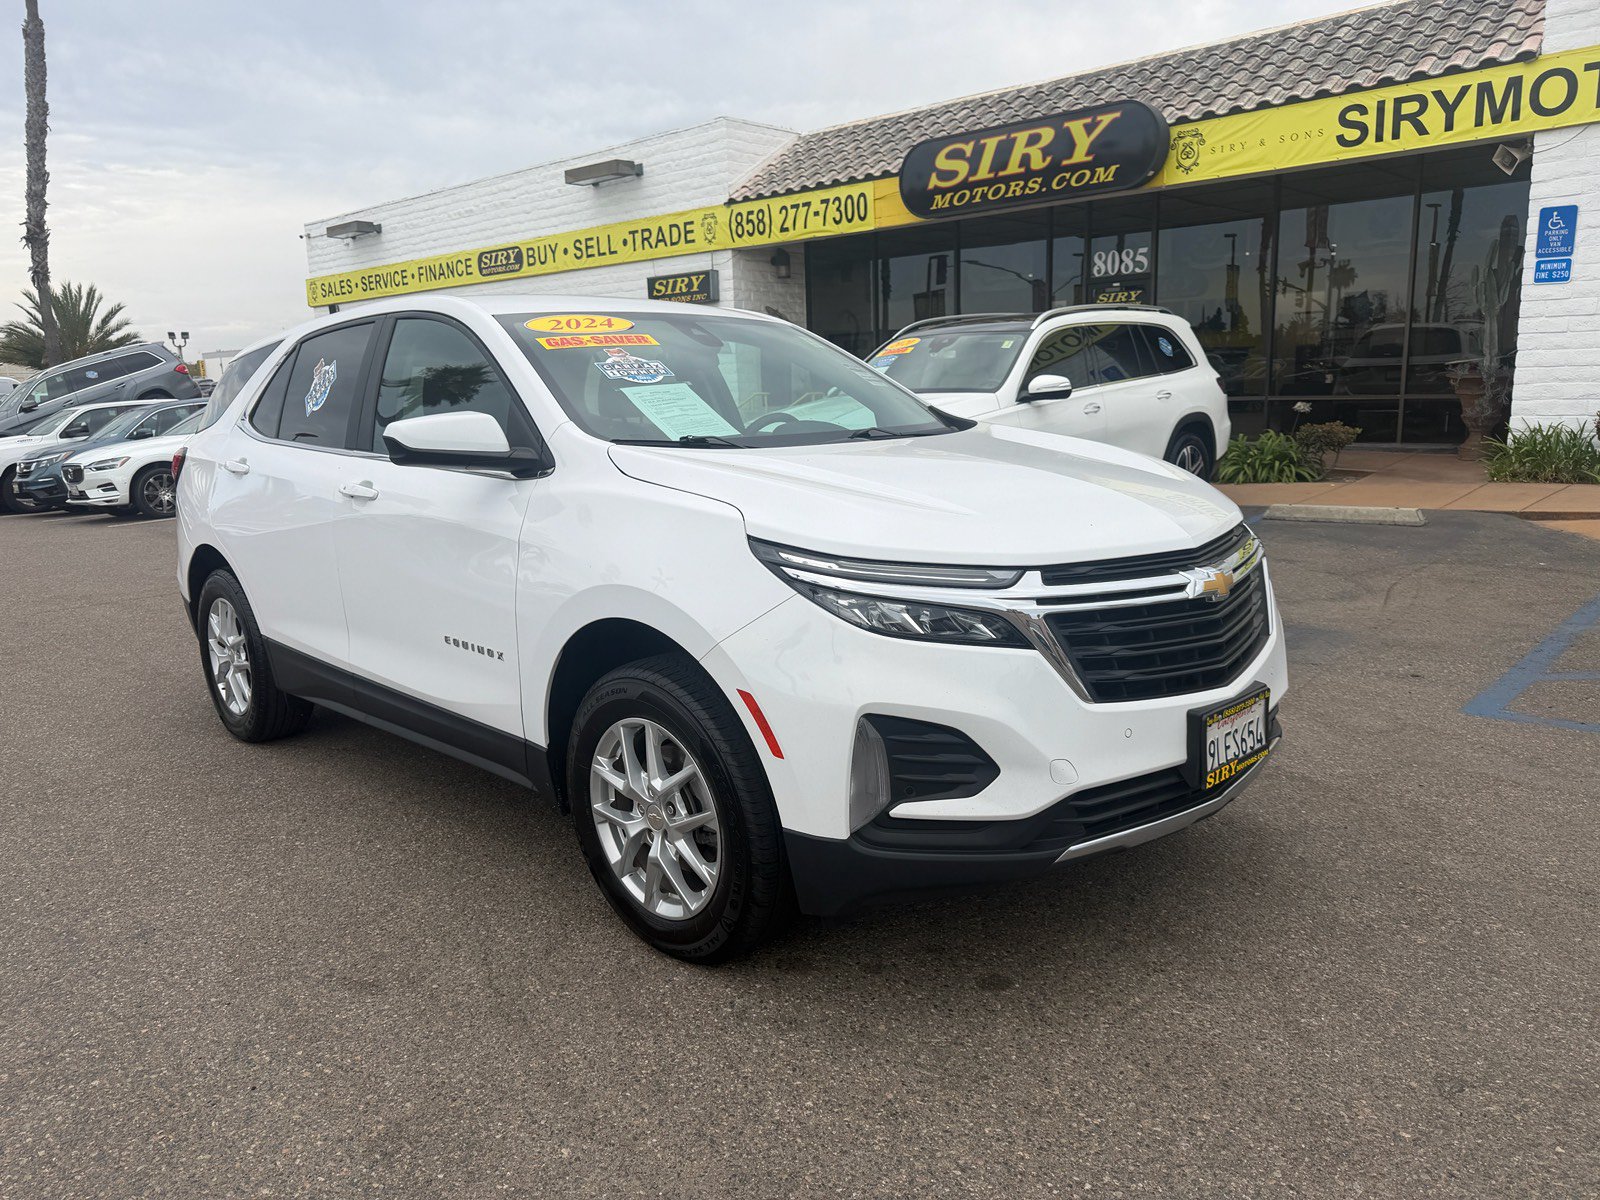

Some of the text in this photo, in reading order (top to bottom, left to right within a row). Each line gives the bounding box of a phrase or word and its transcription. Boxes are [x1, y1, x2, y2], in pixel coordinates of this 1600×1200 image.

[927, 111, 1122, 190] SIRY
[1210, 128, 1325, 155] SIRY & SONS
[930, 164, 1120, 211] MOTORS.COM
[728, 191, 868, 243] (858) 277-7300
[526, 220, 696, 267] BUY SELL TRADE
[1544, 228, 1569, 236] PARKING
[481, 248, 519, 268] SIRY
[1093, 247, 1149, 277] 8085
[1537, 246, 1573, 254] ACCESSIBLE
[320, 258, 473, 298] SALES SERVICE FINANCE
[1536, 270, 1569, 279] FINE $250
[1540, 262, 1567, 270] MINIMUM
[652, 274, 706, 297] SIRY
[1098, 290, 1143, 303] SIRY
[547, 317, 615, 331] 2024
[444, 635, 504, 662] EQUINOX
[1208, 716, 1264, 773] 9LES654
[1206, 759, 1239, 790] SIRY
